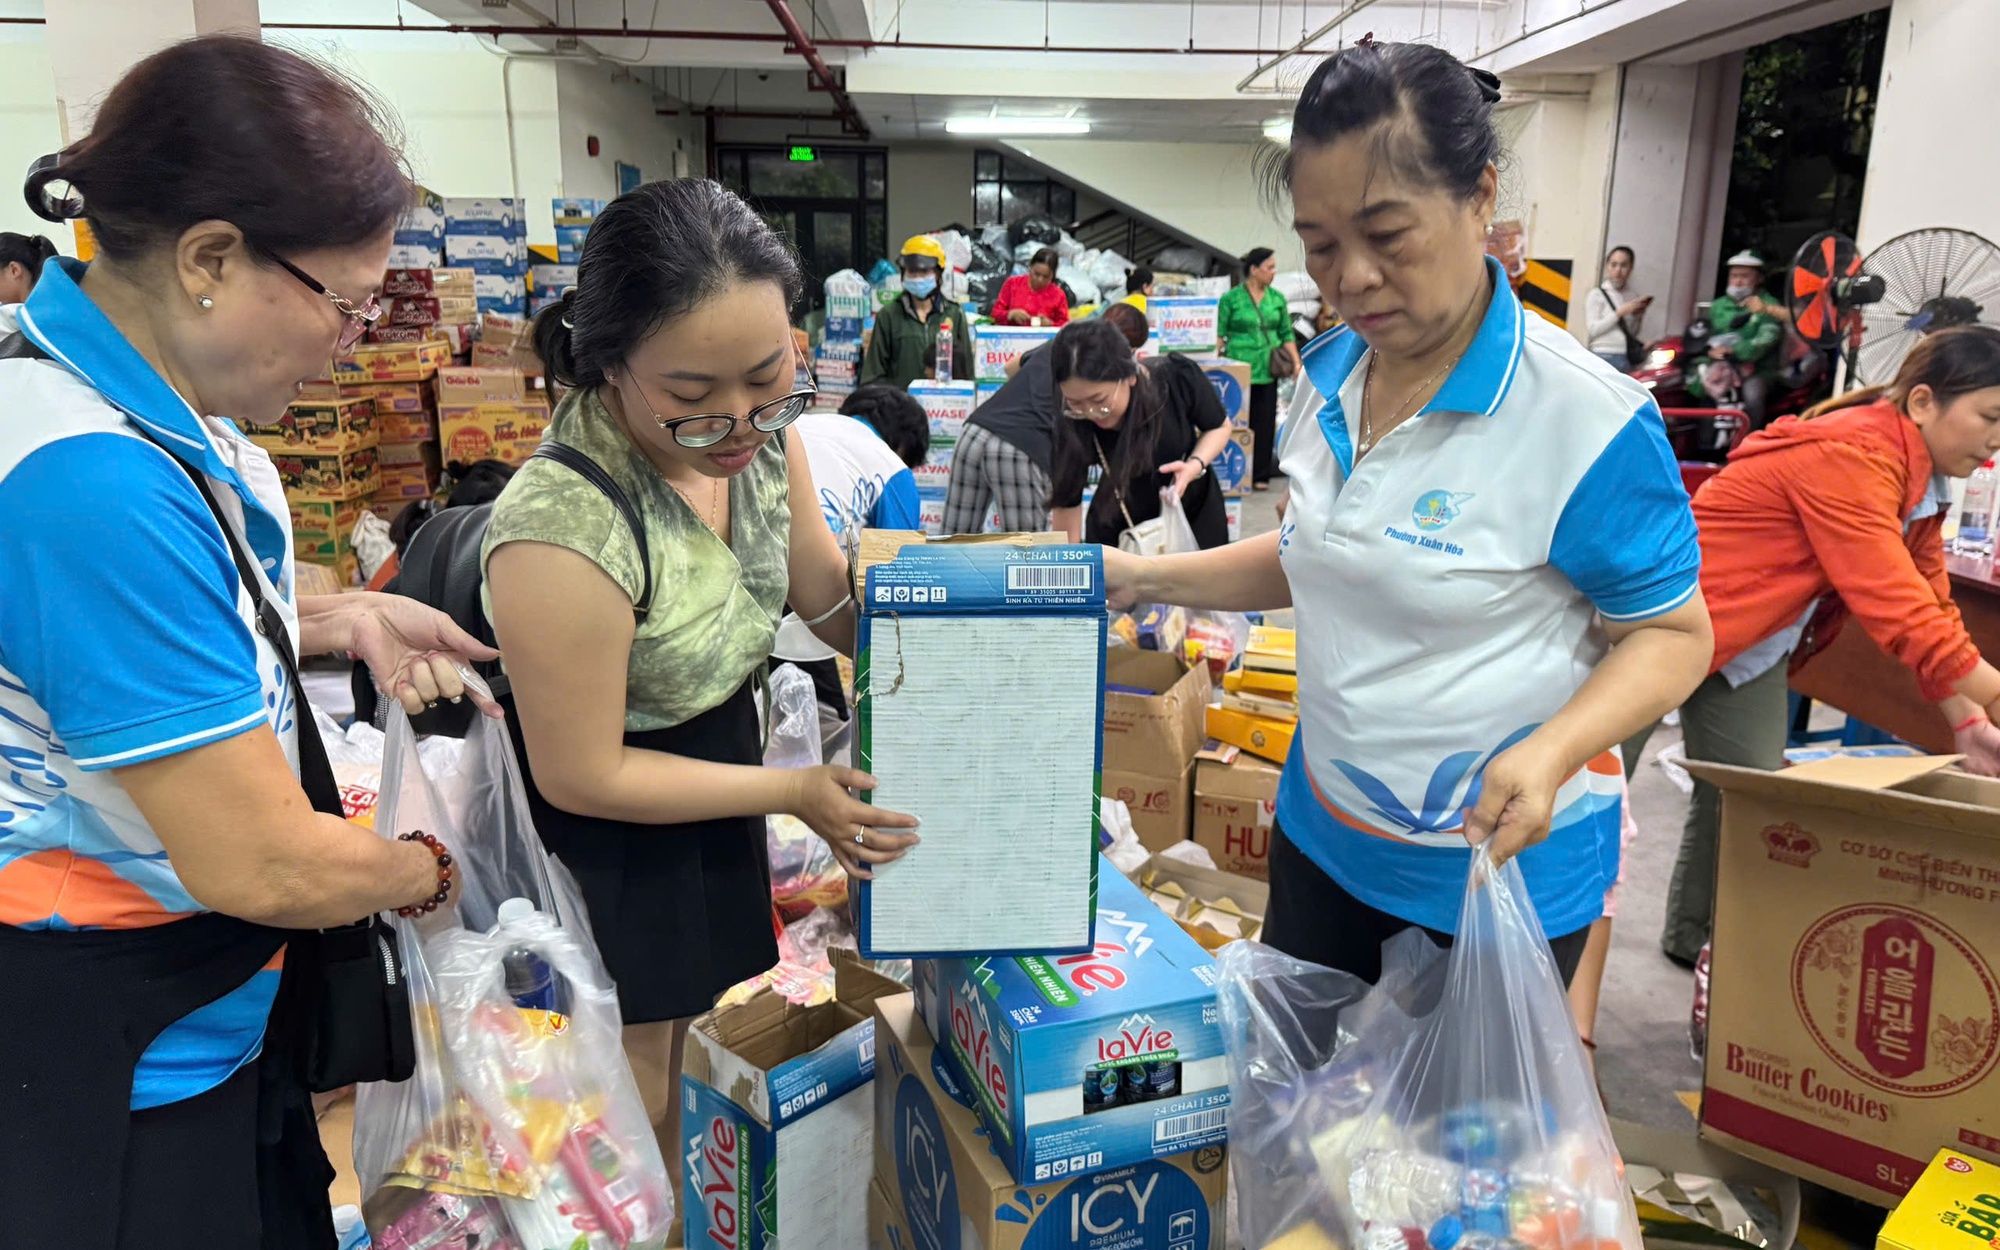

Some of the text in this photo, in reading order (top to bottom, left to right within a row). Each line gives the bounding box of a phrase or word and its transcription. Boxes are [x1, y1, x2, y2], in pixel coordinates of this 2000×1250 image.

[1164, 318, 1212, 329] BIWASE
[926, 408, 967, 419] WASE
[1384, 526, 1465, 556] Phường Xuân Hòa
[1005, 551, 1019, 560] 24
[1023, 551, 1052, 561] CHAI
[1038, 976, 1070, 1003] NHIÊN
[950, 984, 1008, 1110] laVie
[1098, 1025, 1174, 1061] laVie
[1726, 1042, 1889, 1123] Butter Cookies
[1154, 1106, 1167, 1116] 24
[1171, 1100, 1197, 1112] CHAI
[741, 1129, 749, 1161] NHIÊN
[1101, 1167, 1136, 1182] VINAMILK
[1876, 1163, 1910, 1188] SL:
[741, 1194, 749, 1235] KHOÁNG
[1071, 1172, 1160, 1242] ICY
[1089, 1228, 1136, 1248] PREMIUM
